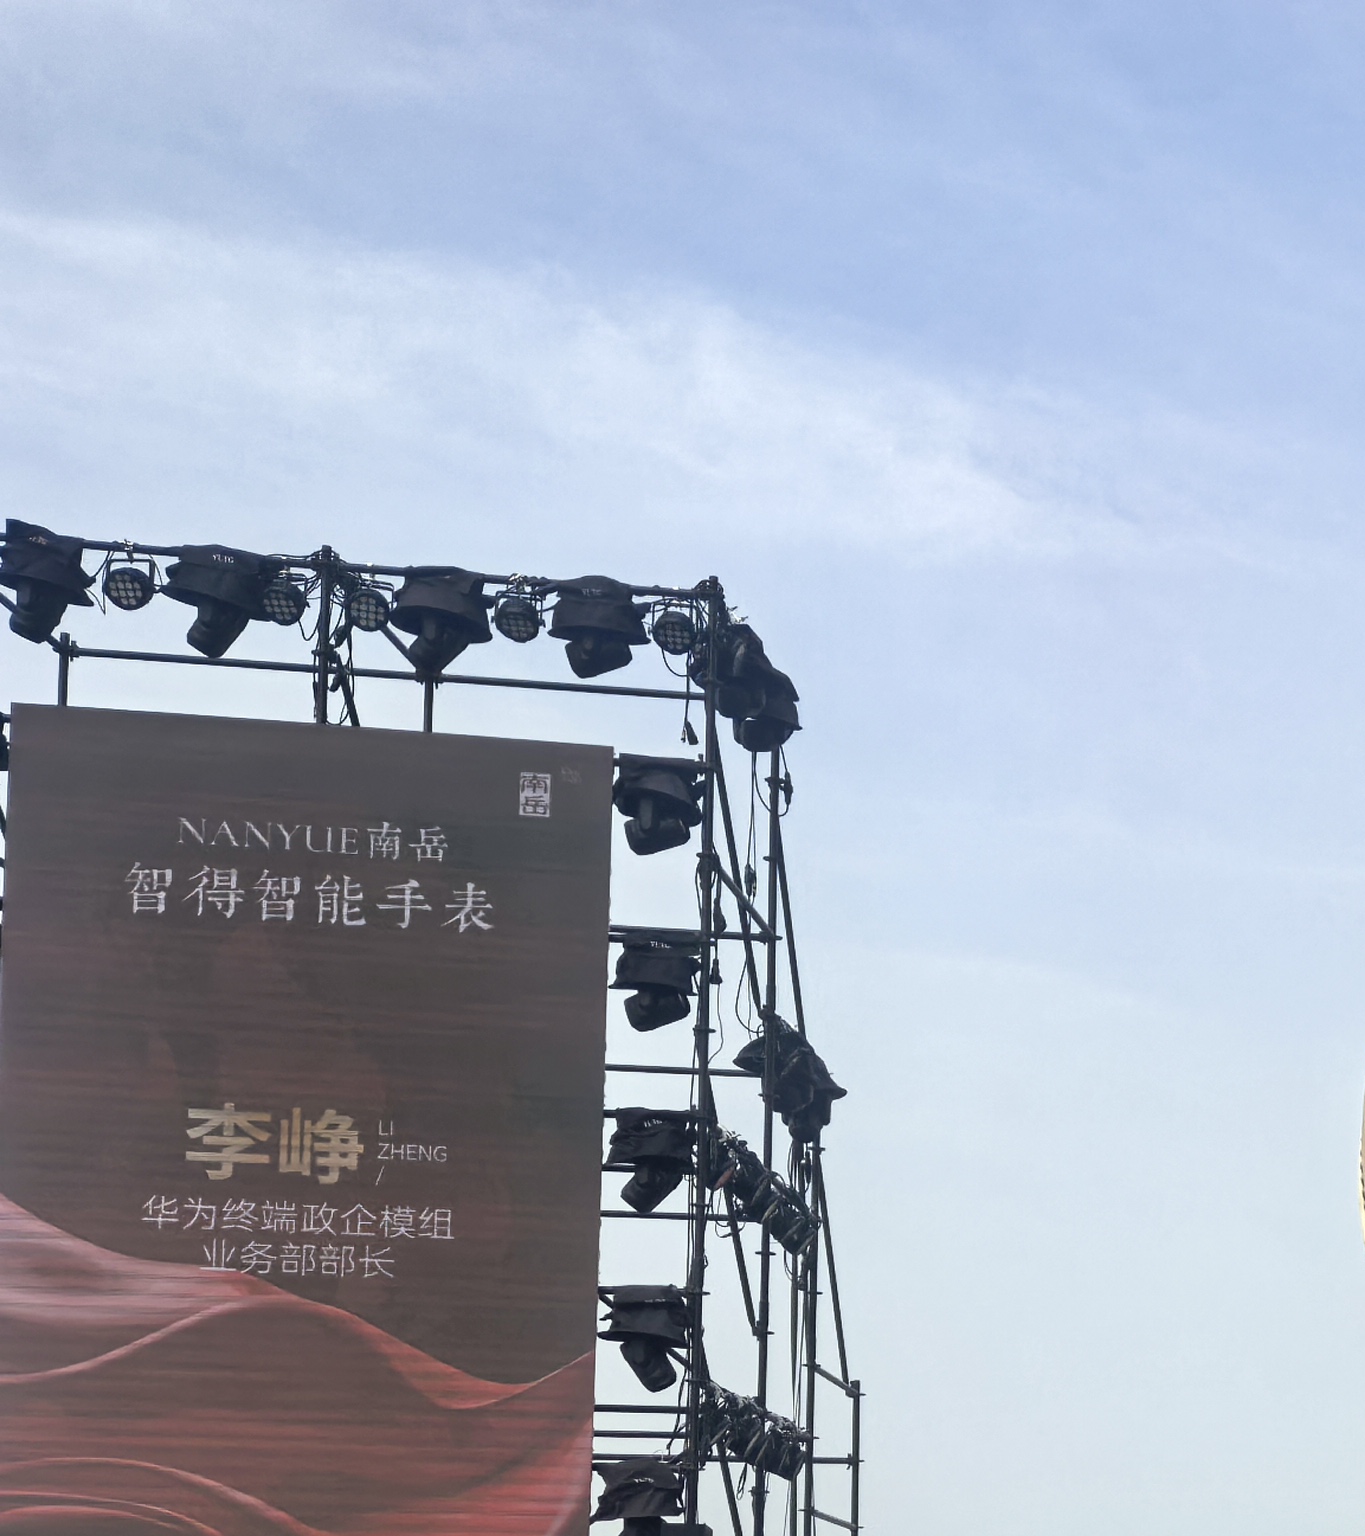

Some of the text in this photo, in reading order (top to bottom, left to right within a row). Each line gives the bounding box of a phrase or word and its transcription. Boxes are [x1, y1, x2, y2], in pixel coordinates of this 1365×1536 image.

[124, 861, 495, 933] 智得智能手表
[185, 1102, 364, 1185] 李峥
[378, 1119, 394, 1137] LI
[377, 1142, 448, 1164] ZHENG
[141, 1194, 455, 1240] 华为终端政企模组
[200, 1237, 395, 1278] 业务部部长
